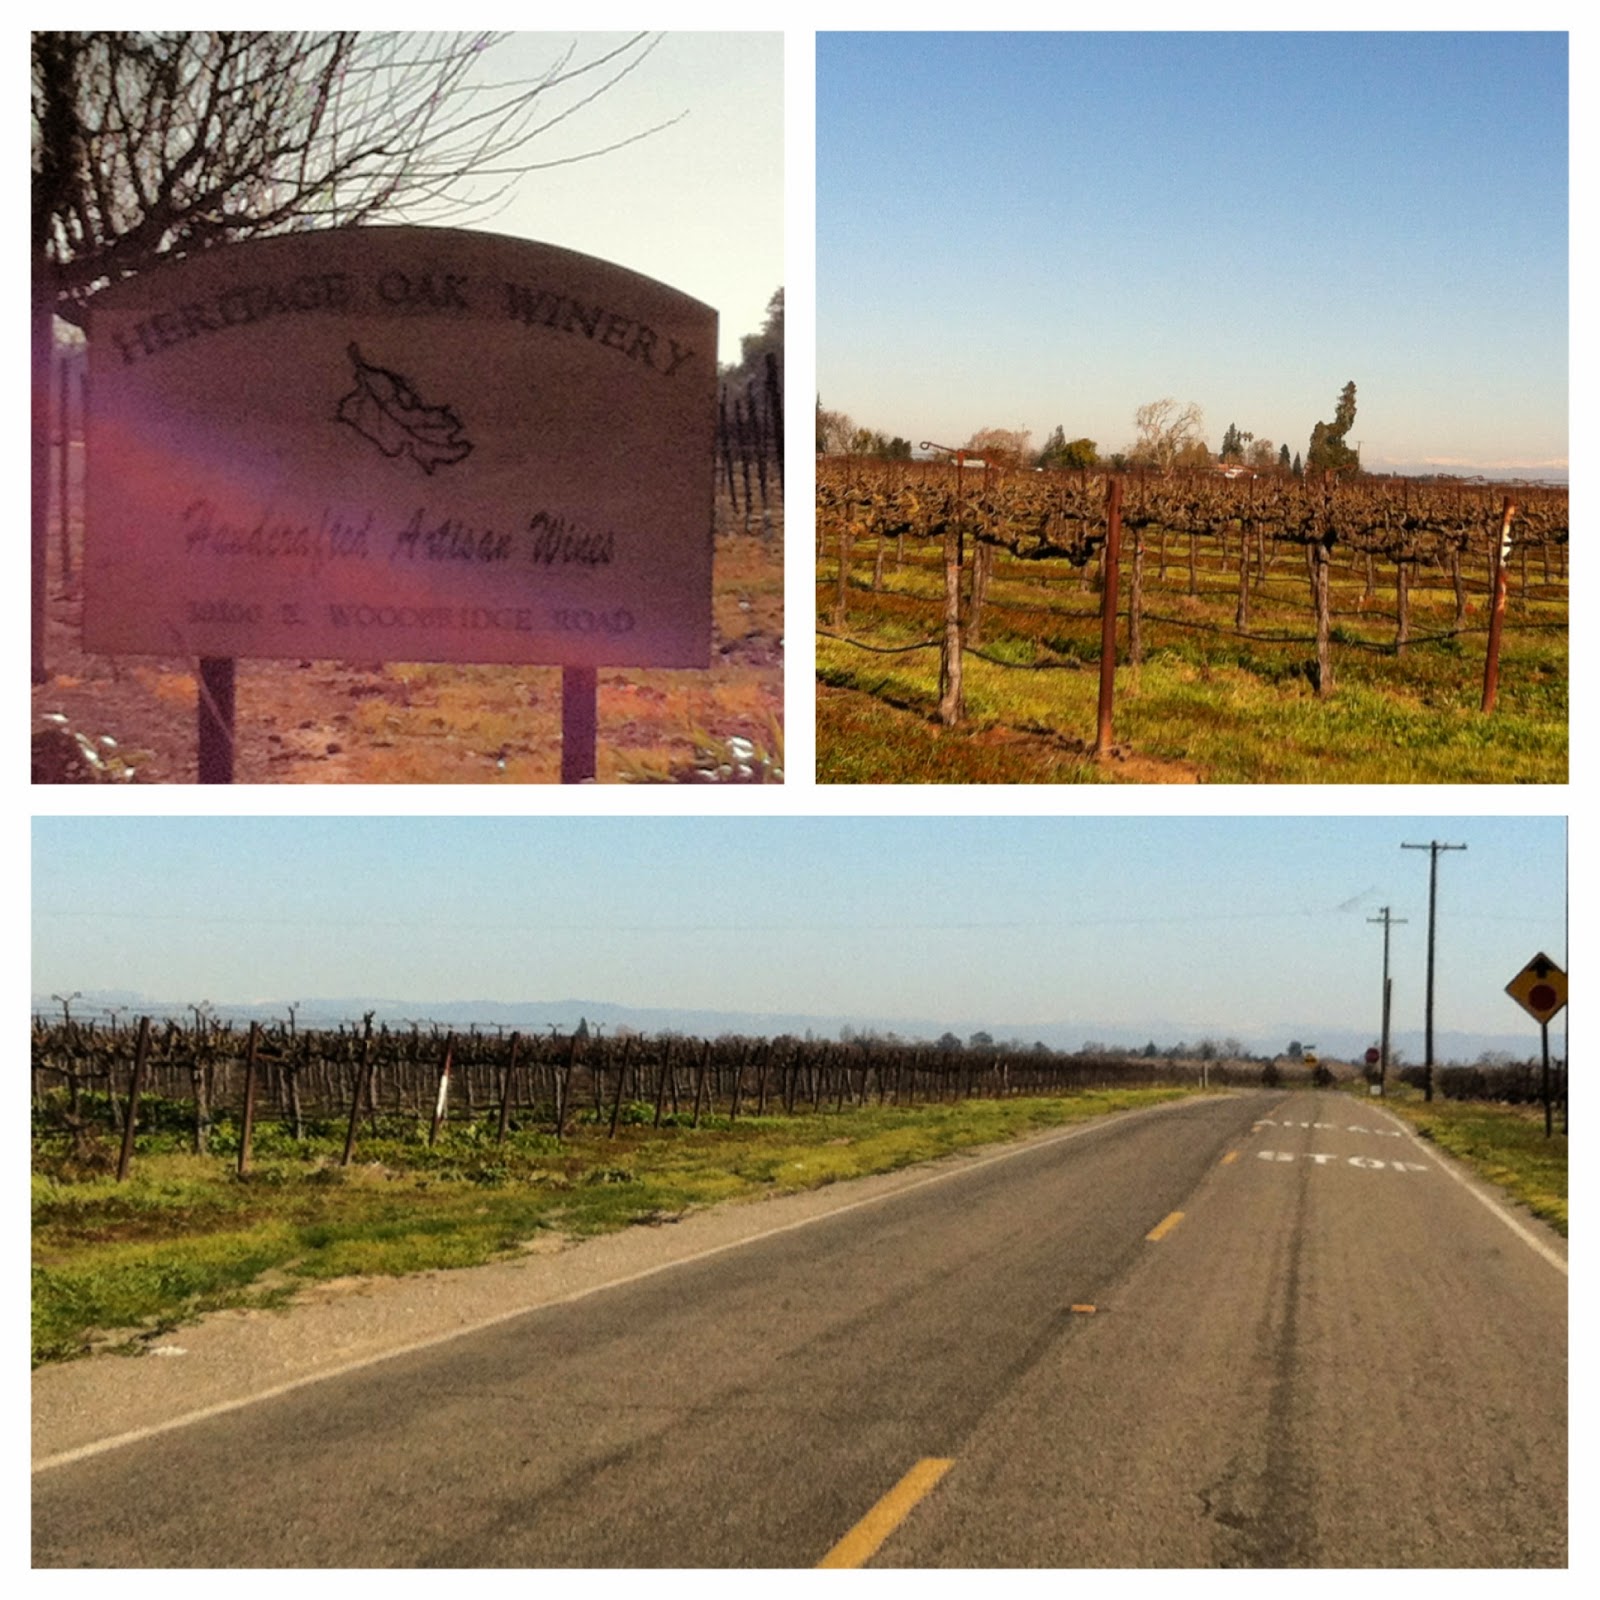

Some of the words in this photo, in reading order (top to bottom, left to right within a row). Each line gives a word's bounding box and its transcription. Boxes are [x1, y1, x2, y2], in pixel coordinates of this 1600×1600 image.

[111, 272, 351, 365] HERITAGE
[378, 270, 471, 309] OAK
[503, 282, 696, 376] WINERY
[183, 498, 375, 577] Handcrafted
[391, 507, 514, 562] Artisan
[530, 509, 615, 565] Wines
[329, 603, 533, 631] WOODBRIDGE
[553, 605, 637, 633] ROAD
[1253, 1118, 1401, 1138] AHEAD
[1257, 1150, 1429, 1173] STOP
